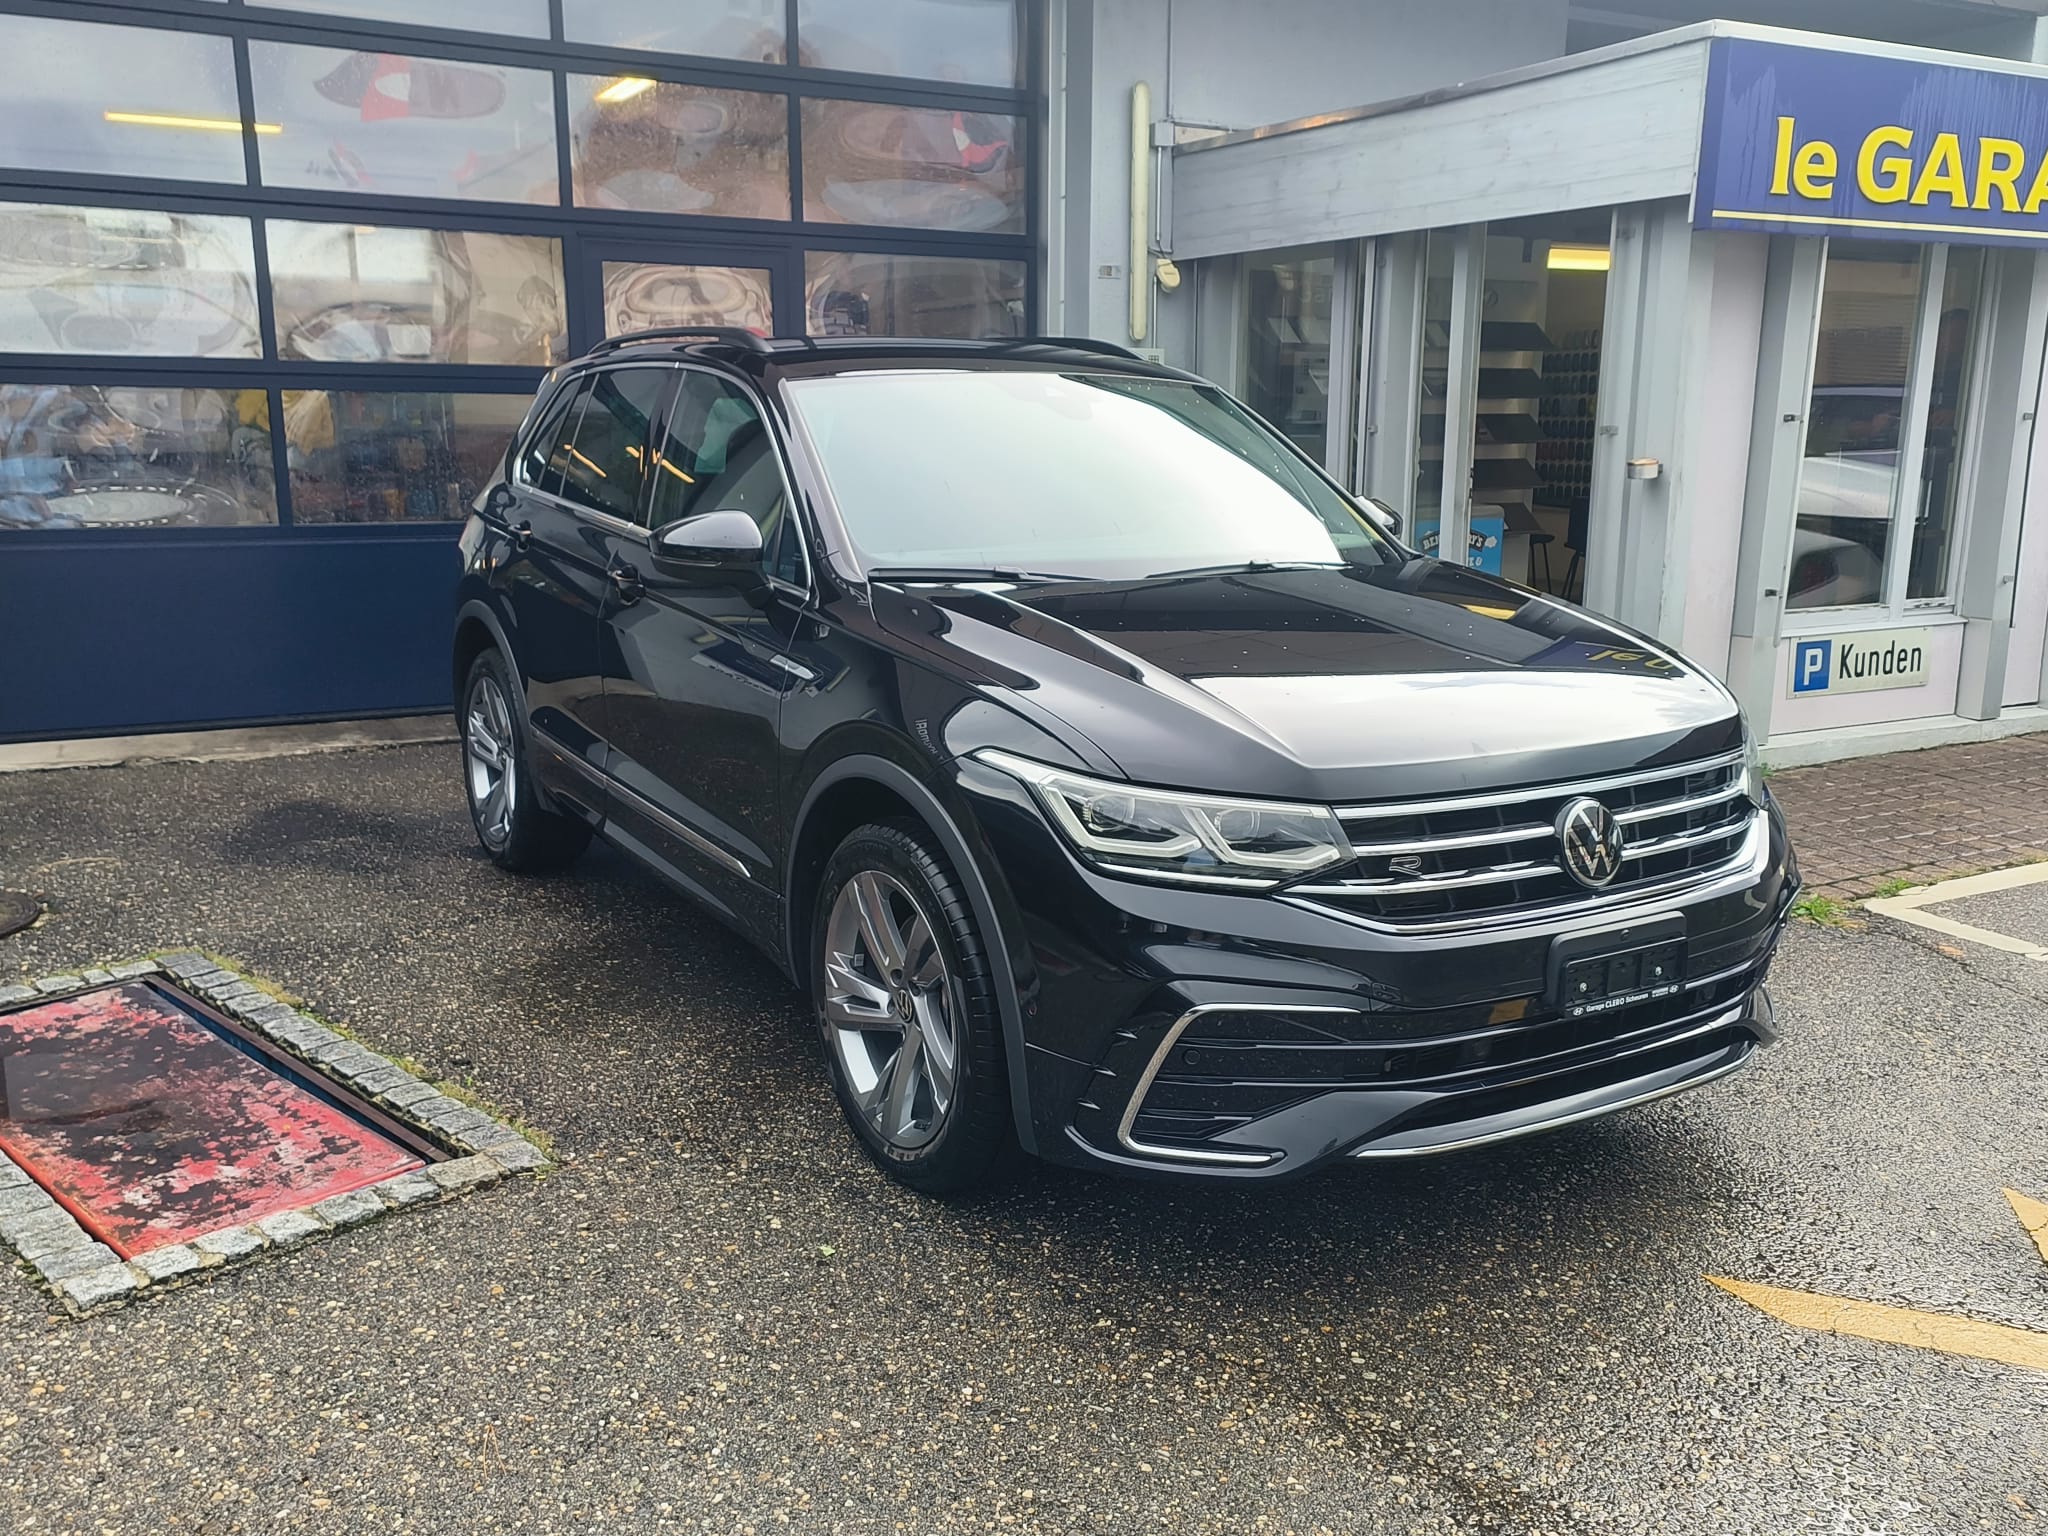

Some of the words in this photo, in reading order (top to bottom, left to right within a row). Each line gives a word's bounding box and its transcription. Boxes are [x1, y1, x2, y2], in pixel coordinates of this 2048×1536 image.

[1770, 117, 1837, 199] le
[1803, 648, 1823, 686] P
[1839, 640, 1922, 679] Kunden
[1586, 1003, 1605, 1012] Garage
